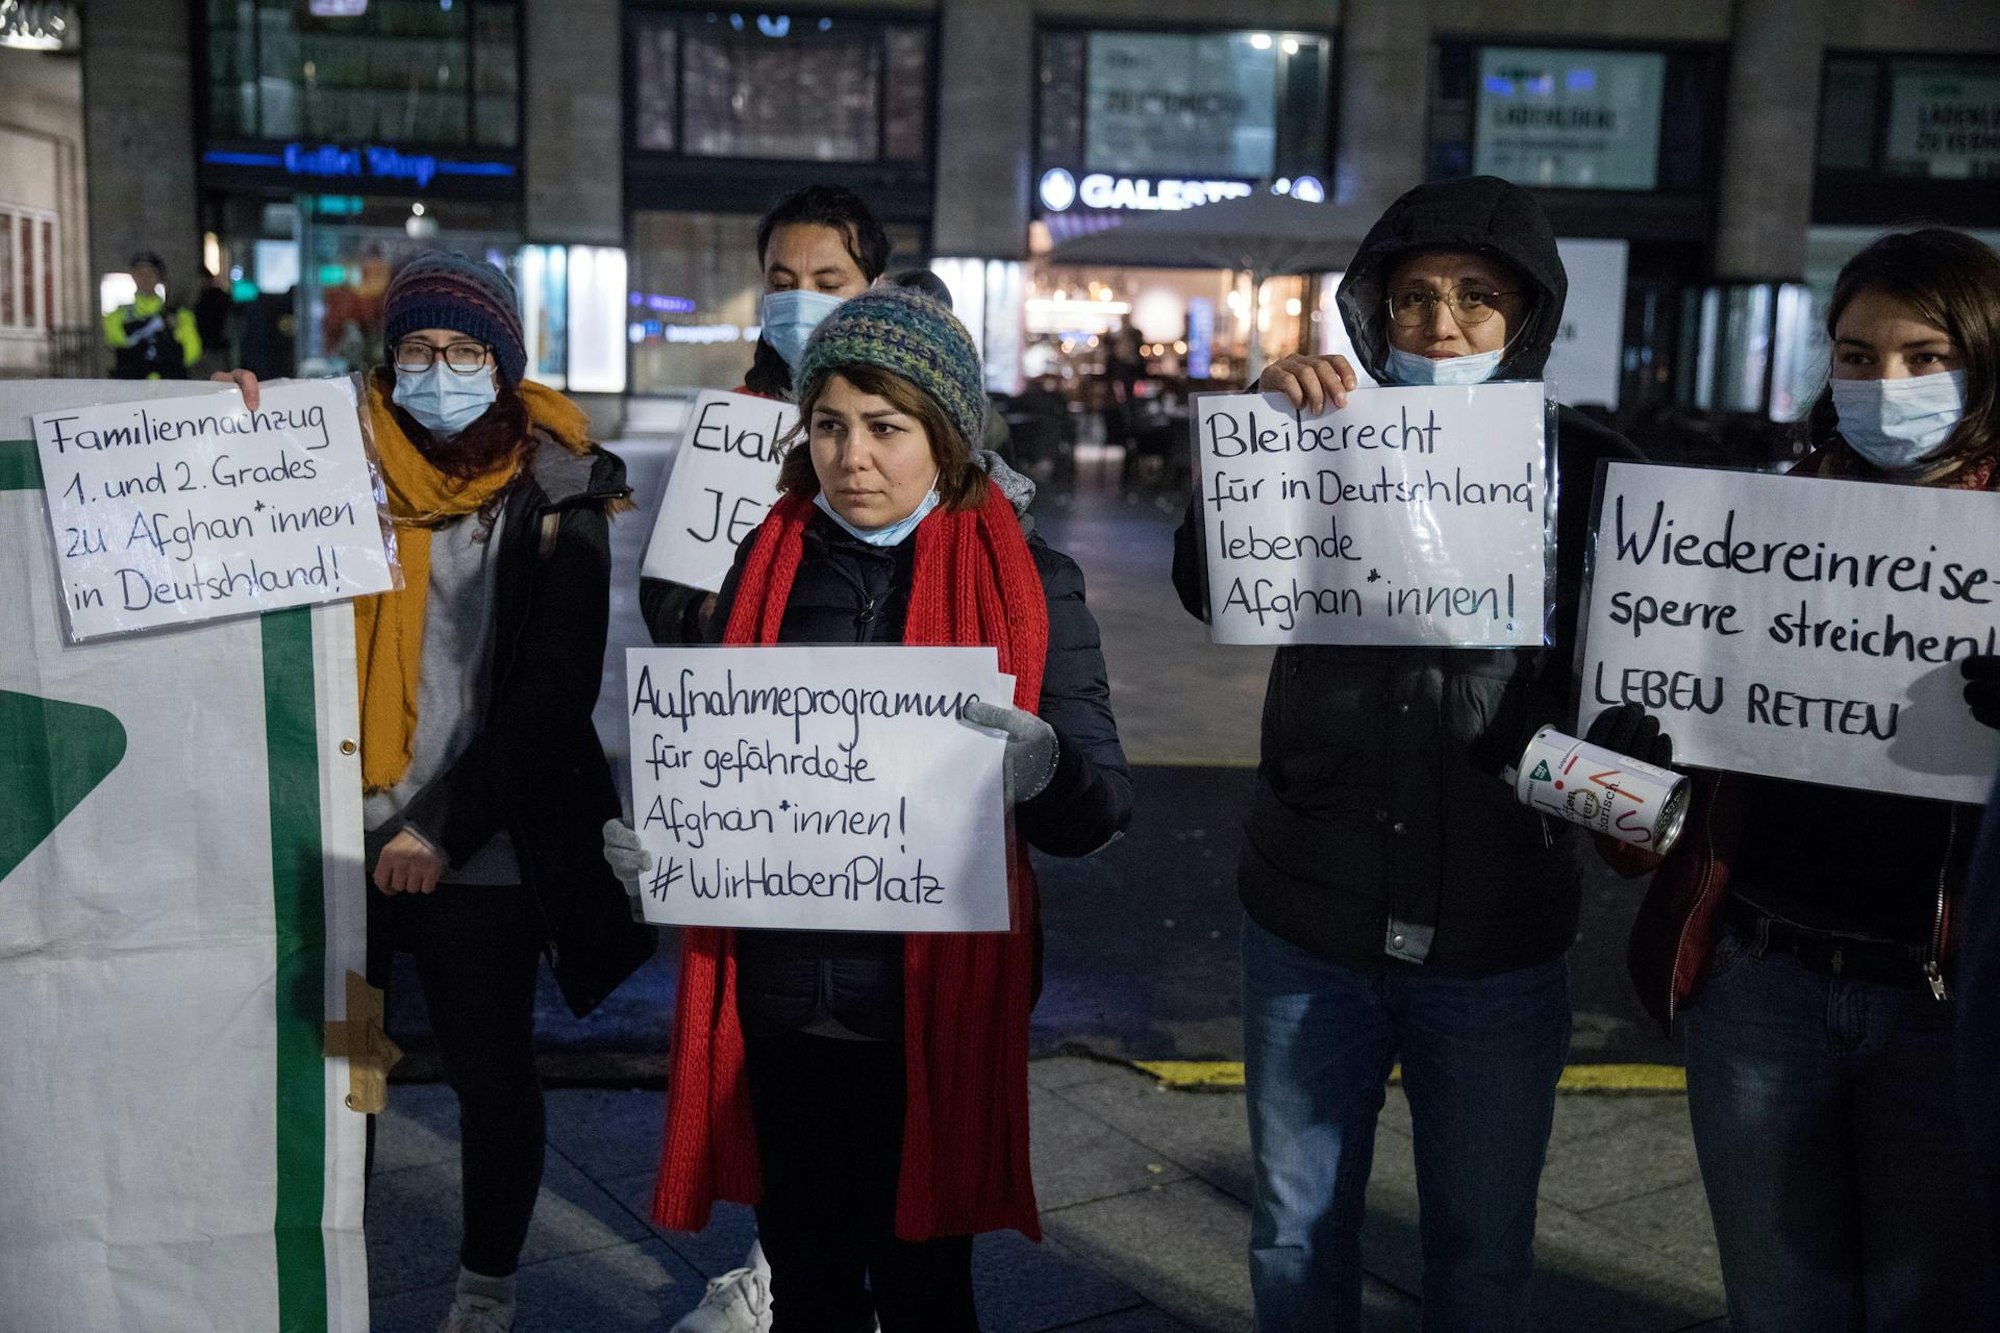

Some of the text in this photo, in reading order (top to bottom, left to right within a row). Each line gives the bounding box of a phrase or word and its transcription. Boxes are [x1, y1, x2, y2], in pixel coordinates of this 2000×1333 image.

[43, 405, 330, 453] Familiennachzug
[1206, 406, 1442, 458] Bleiberecht
[63, 450, 317, 505] 1. und 2. Grades
[1208, 462, 1534, 512] für in Deutschland
[66, 527, 108, 558] zu
[1220, 515, 1362, 560] lebende
[74, 545, 341, 612] in Deutschland!
[1609, 590, 1743, 638] sperre
[1595, 661, 1900, 741] LEBEN RETTEN
[646, 734, 875, 788] für gefährdete
[650, 855, 944, 903] #WirHabenPlatz
